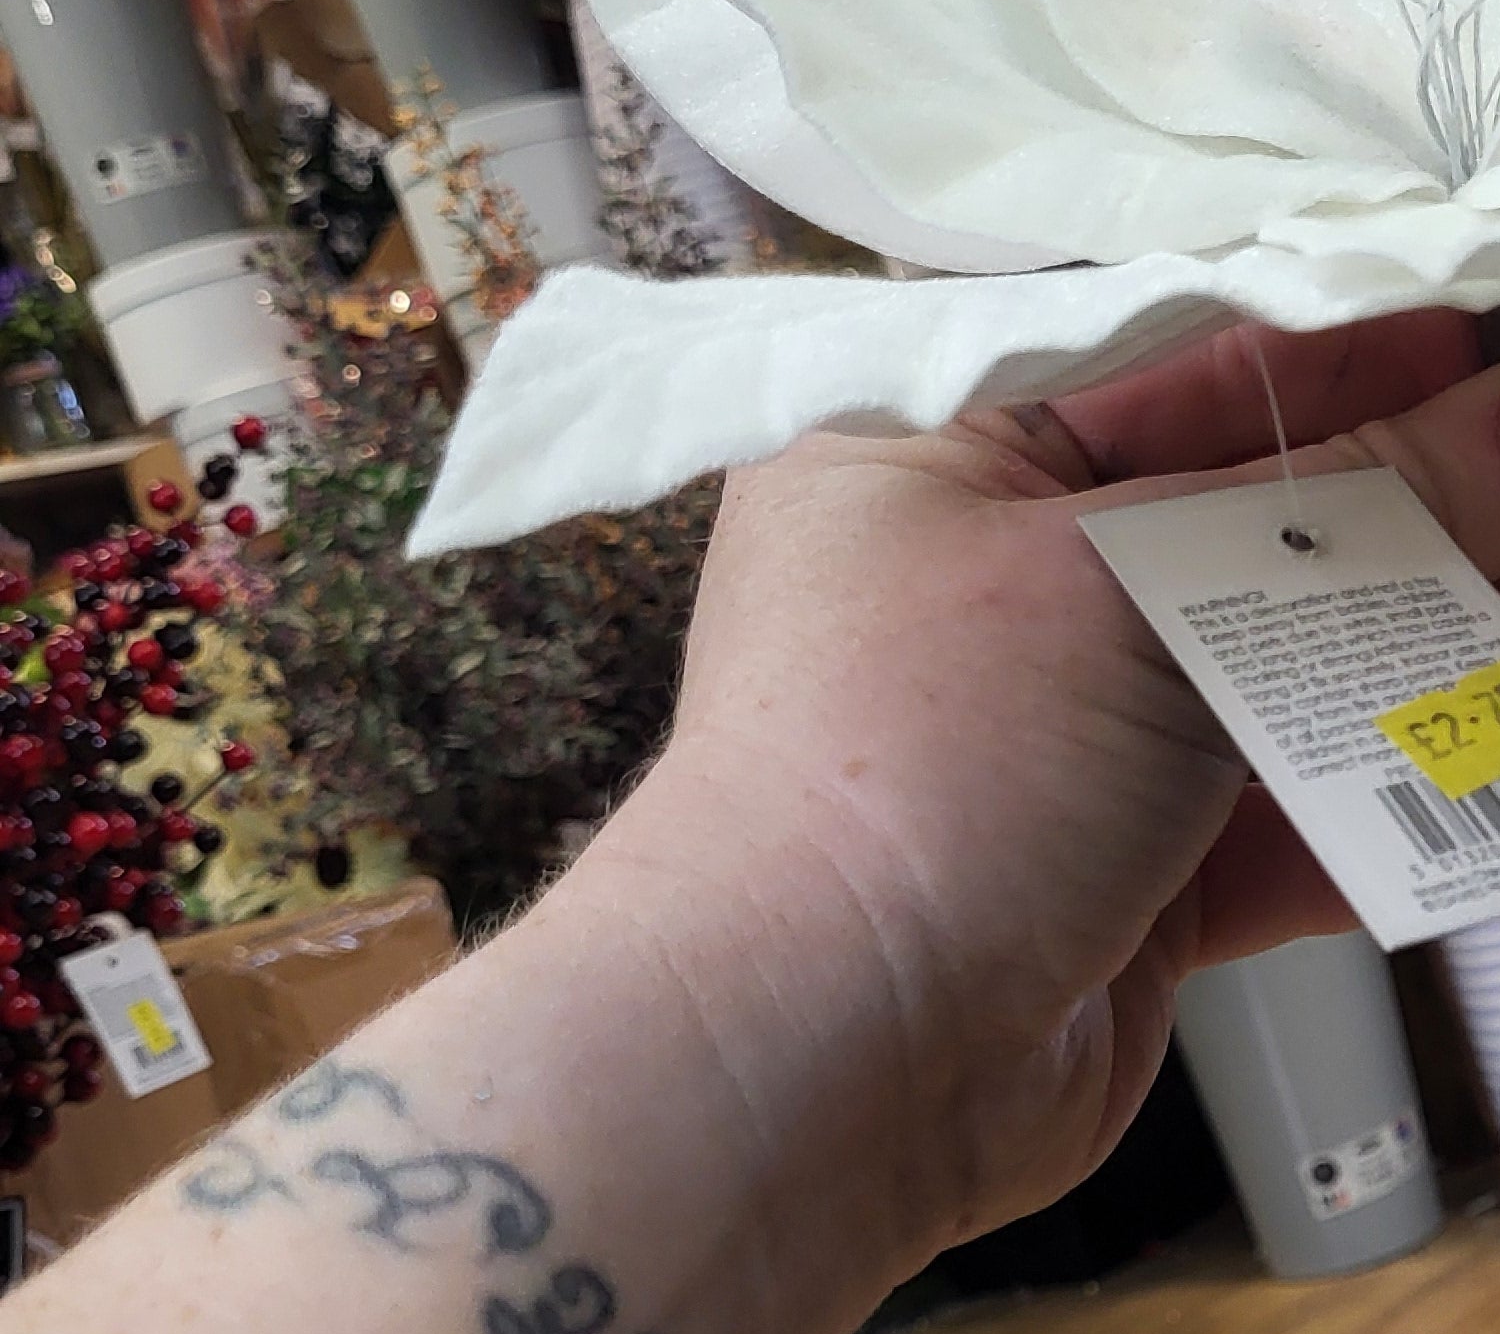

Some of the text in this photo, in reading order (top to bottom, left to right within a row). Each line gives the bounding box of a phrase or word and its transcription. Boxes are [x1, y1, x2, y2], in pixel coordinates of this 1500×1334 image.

[1178, 591, 1268, 617] WARNING!
[1188, 618, 1219, 631] This
[1218, 614, 1234, 626] is
[1235, 613, 1249, 623] a
[1250, 593, 1337, 619] decoration
[1340, 585, 1374, 599] and
[1372, 581, 1400, 594] not
[1400, 581, 1416, 590] a
[1200, 629, 1246, 645] Keep
[1248, 619, 1295, 637] away
[1294, 609, 1334, 624] from
[1393, 589, 1453, 605] children
[1212, 645, 1247, 661] and
[1286, 629, 1320, 643] due
[1320, 623, 1341, 635] to
[1386, 607, 1424, 623] small
[1424, 602, 1463, 617] parts
[1222, 611, 1492, 675] and long cords which may cause a
[1232, 667, 1301, 689] choking
[1300, 662, 1318, 673] or
[1320, 639, 1420, 669] strangulation
[1241, 685, 1292, 705] Hang
[1292, 682, 1308, 692] or
[1309, 676, 1329, 688] fix
[1400, 649, 1451, 667] Indoor
[1454, 645, 1480, 657] use
[1252, 703, 1292, 719] May
[1293, 688, 1358, 709] contain
[1358, 677, 1404, 694] sharp
[1454, 657, 1497, 671] Keep
[1265, 690, 1415, 734] away from fire and
[1286, 741, 1353, 765] children
